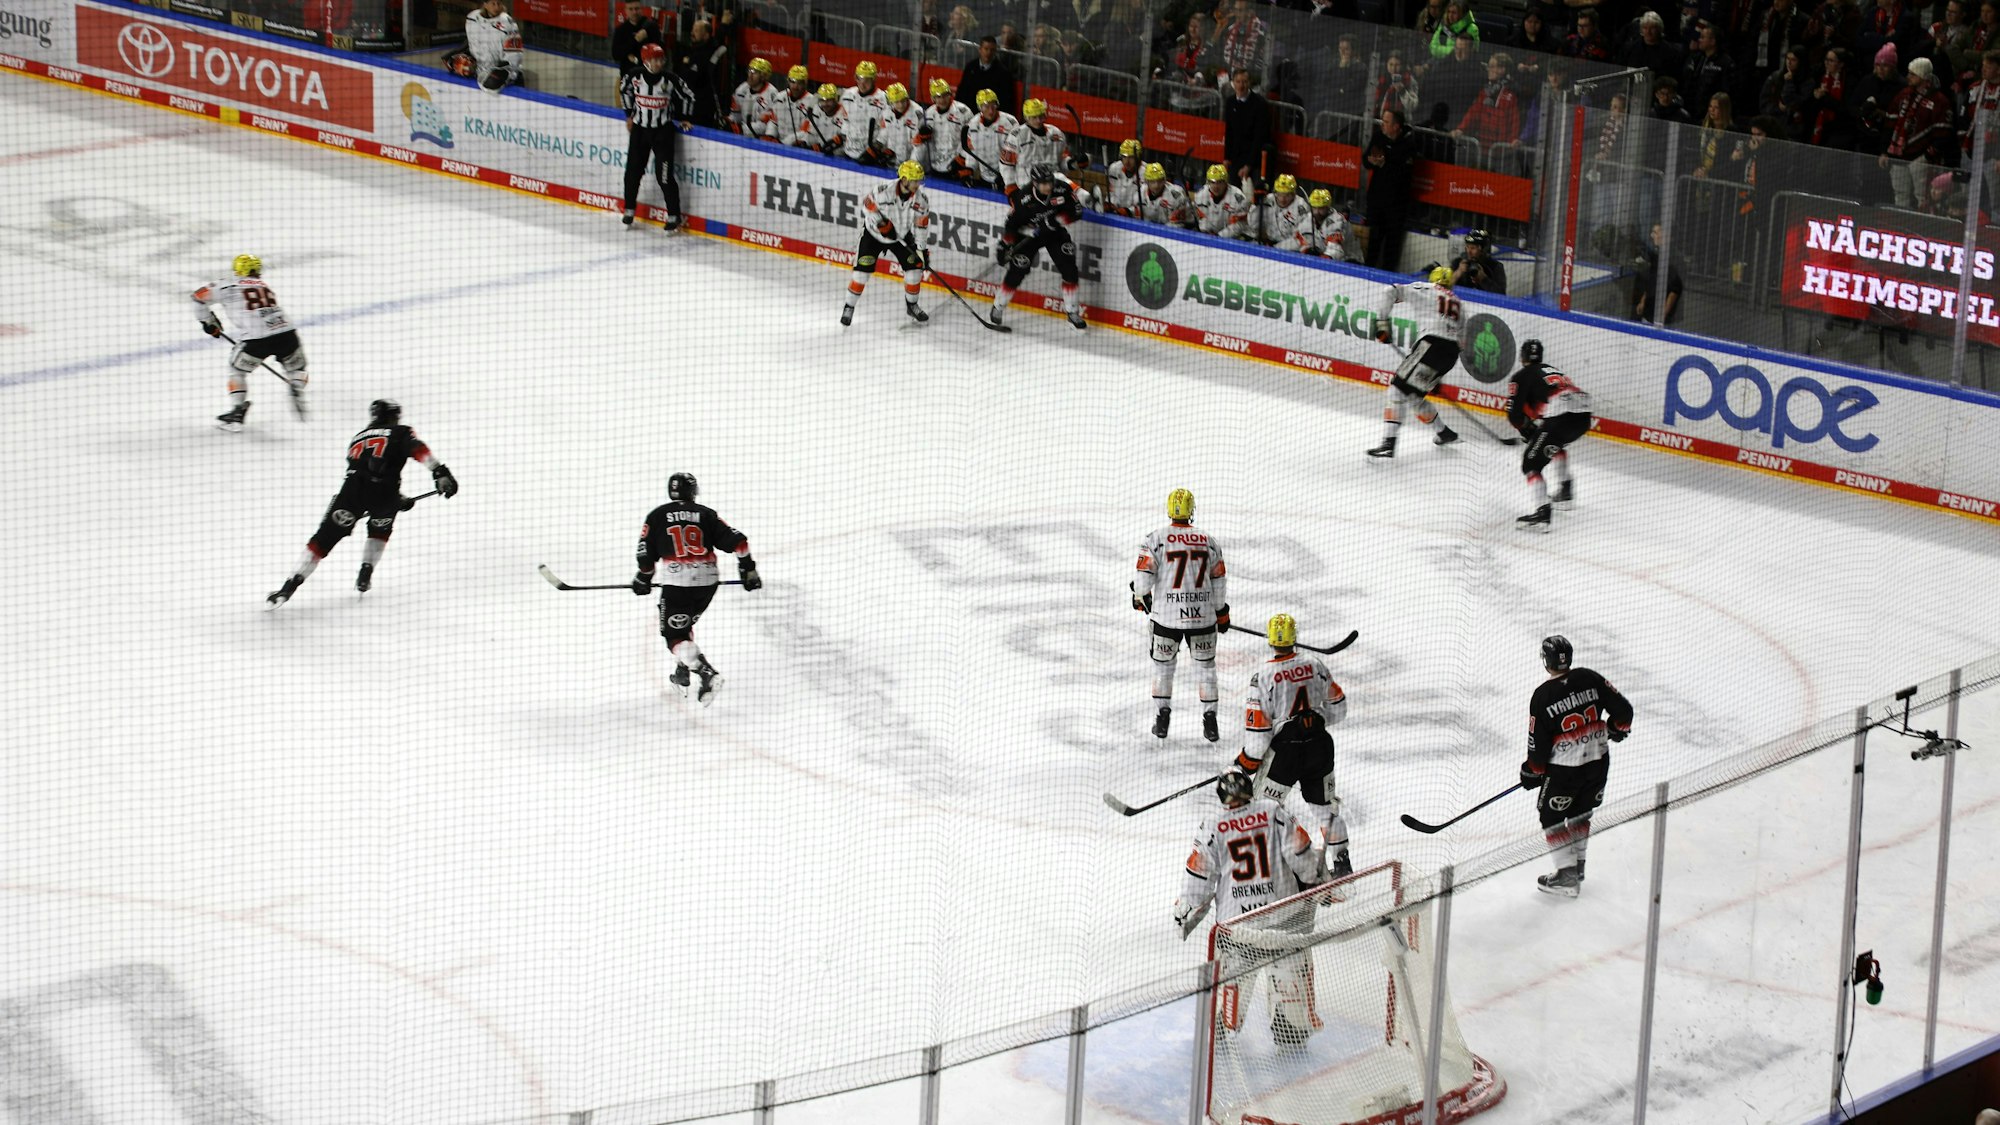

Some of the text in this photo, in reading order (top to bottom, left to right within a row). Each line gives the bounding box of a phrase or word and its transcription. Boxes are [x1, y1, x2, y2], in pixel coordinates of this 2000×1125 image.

[182, 42, 329, 110] TOYOTA
[464, 115, 584, 159] KRANKENHAUS
[1561, 245, 1574, 296] RAITA
[1802, 264, 2000, 328] HEIMSPIEL
[1663, 354, 1879, 453] pape
[666, 510, 700, 523] STORM
[666, 524, 708, 557] 19
[1167, 533, 1207, 546] ORION
[1167, 550, 1210, 588] 77
[1167, 591, 1210, 603] PFAFFENGUT
[1180, 607, 1202, 619] NIX
[1158, 642, 1174, 653] NIX
[1195, 640, 1212, 650] NIX
[1274, 663, 1313, 683] ORION
[1546, 688, 1599, 718] TYRVÄINEN
[1561, 704, 1599, 733] 21
[1264, 786, 1283, 799] NIX
[1217, 811, 1268, 833] ORION
[1227, 834, 1271, 881] 51
[1232, 882, 1274, 898] BRENNER
